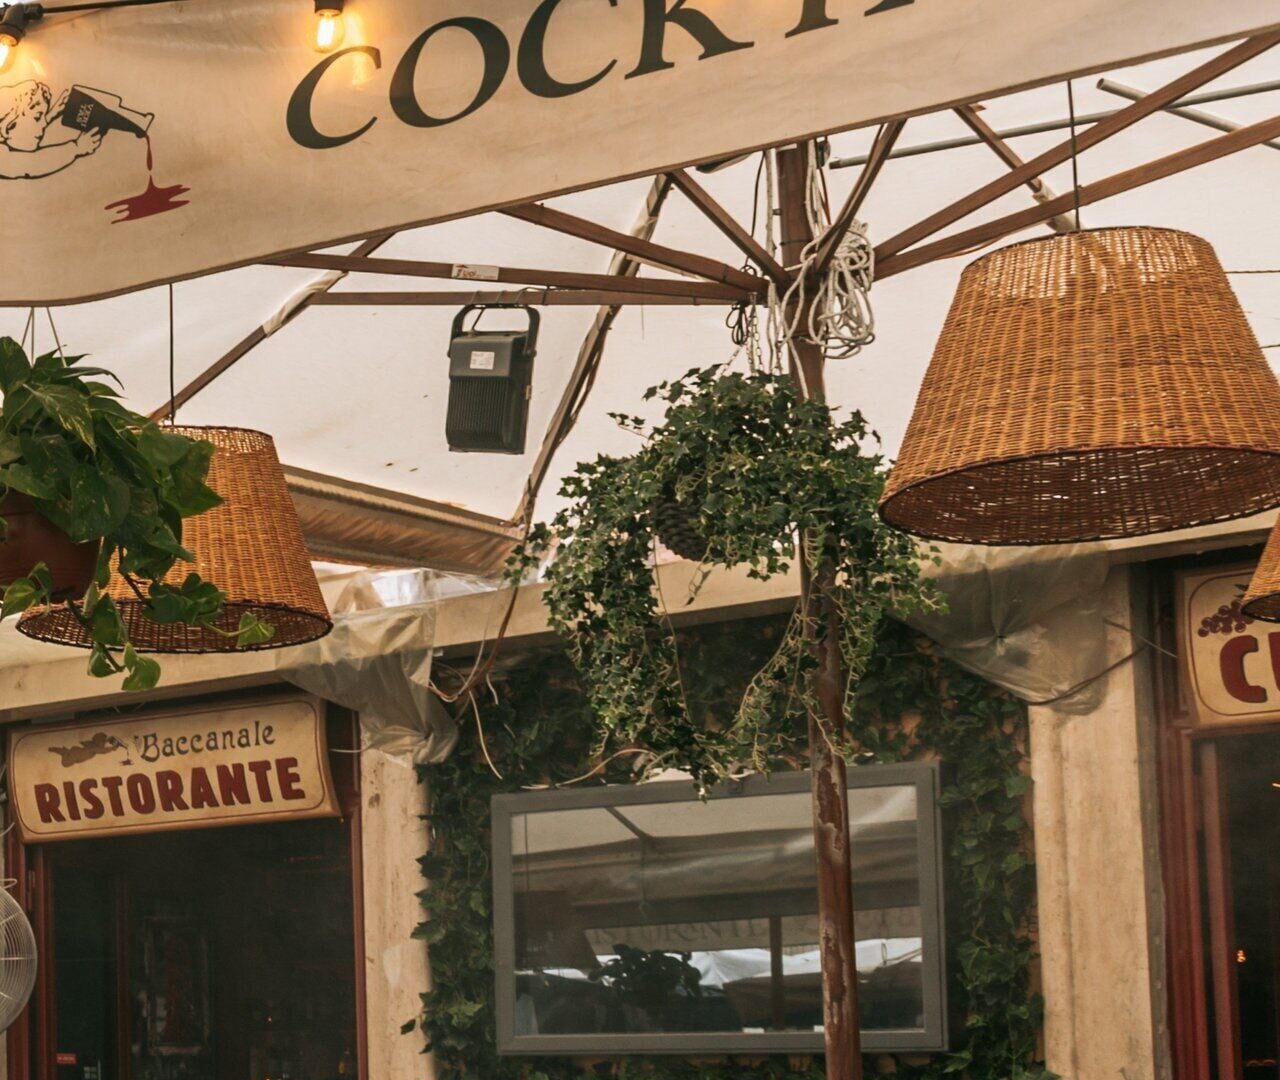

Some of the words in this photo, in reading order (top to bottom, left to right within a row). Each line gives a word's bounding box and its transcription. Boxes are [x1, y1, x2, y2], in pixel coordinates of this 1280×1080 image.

[286, 0, 915, 150] COCK
[139, 720, 276, 763] Baccanale
[33, 756, 307, 824] RISTORANTE
